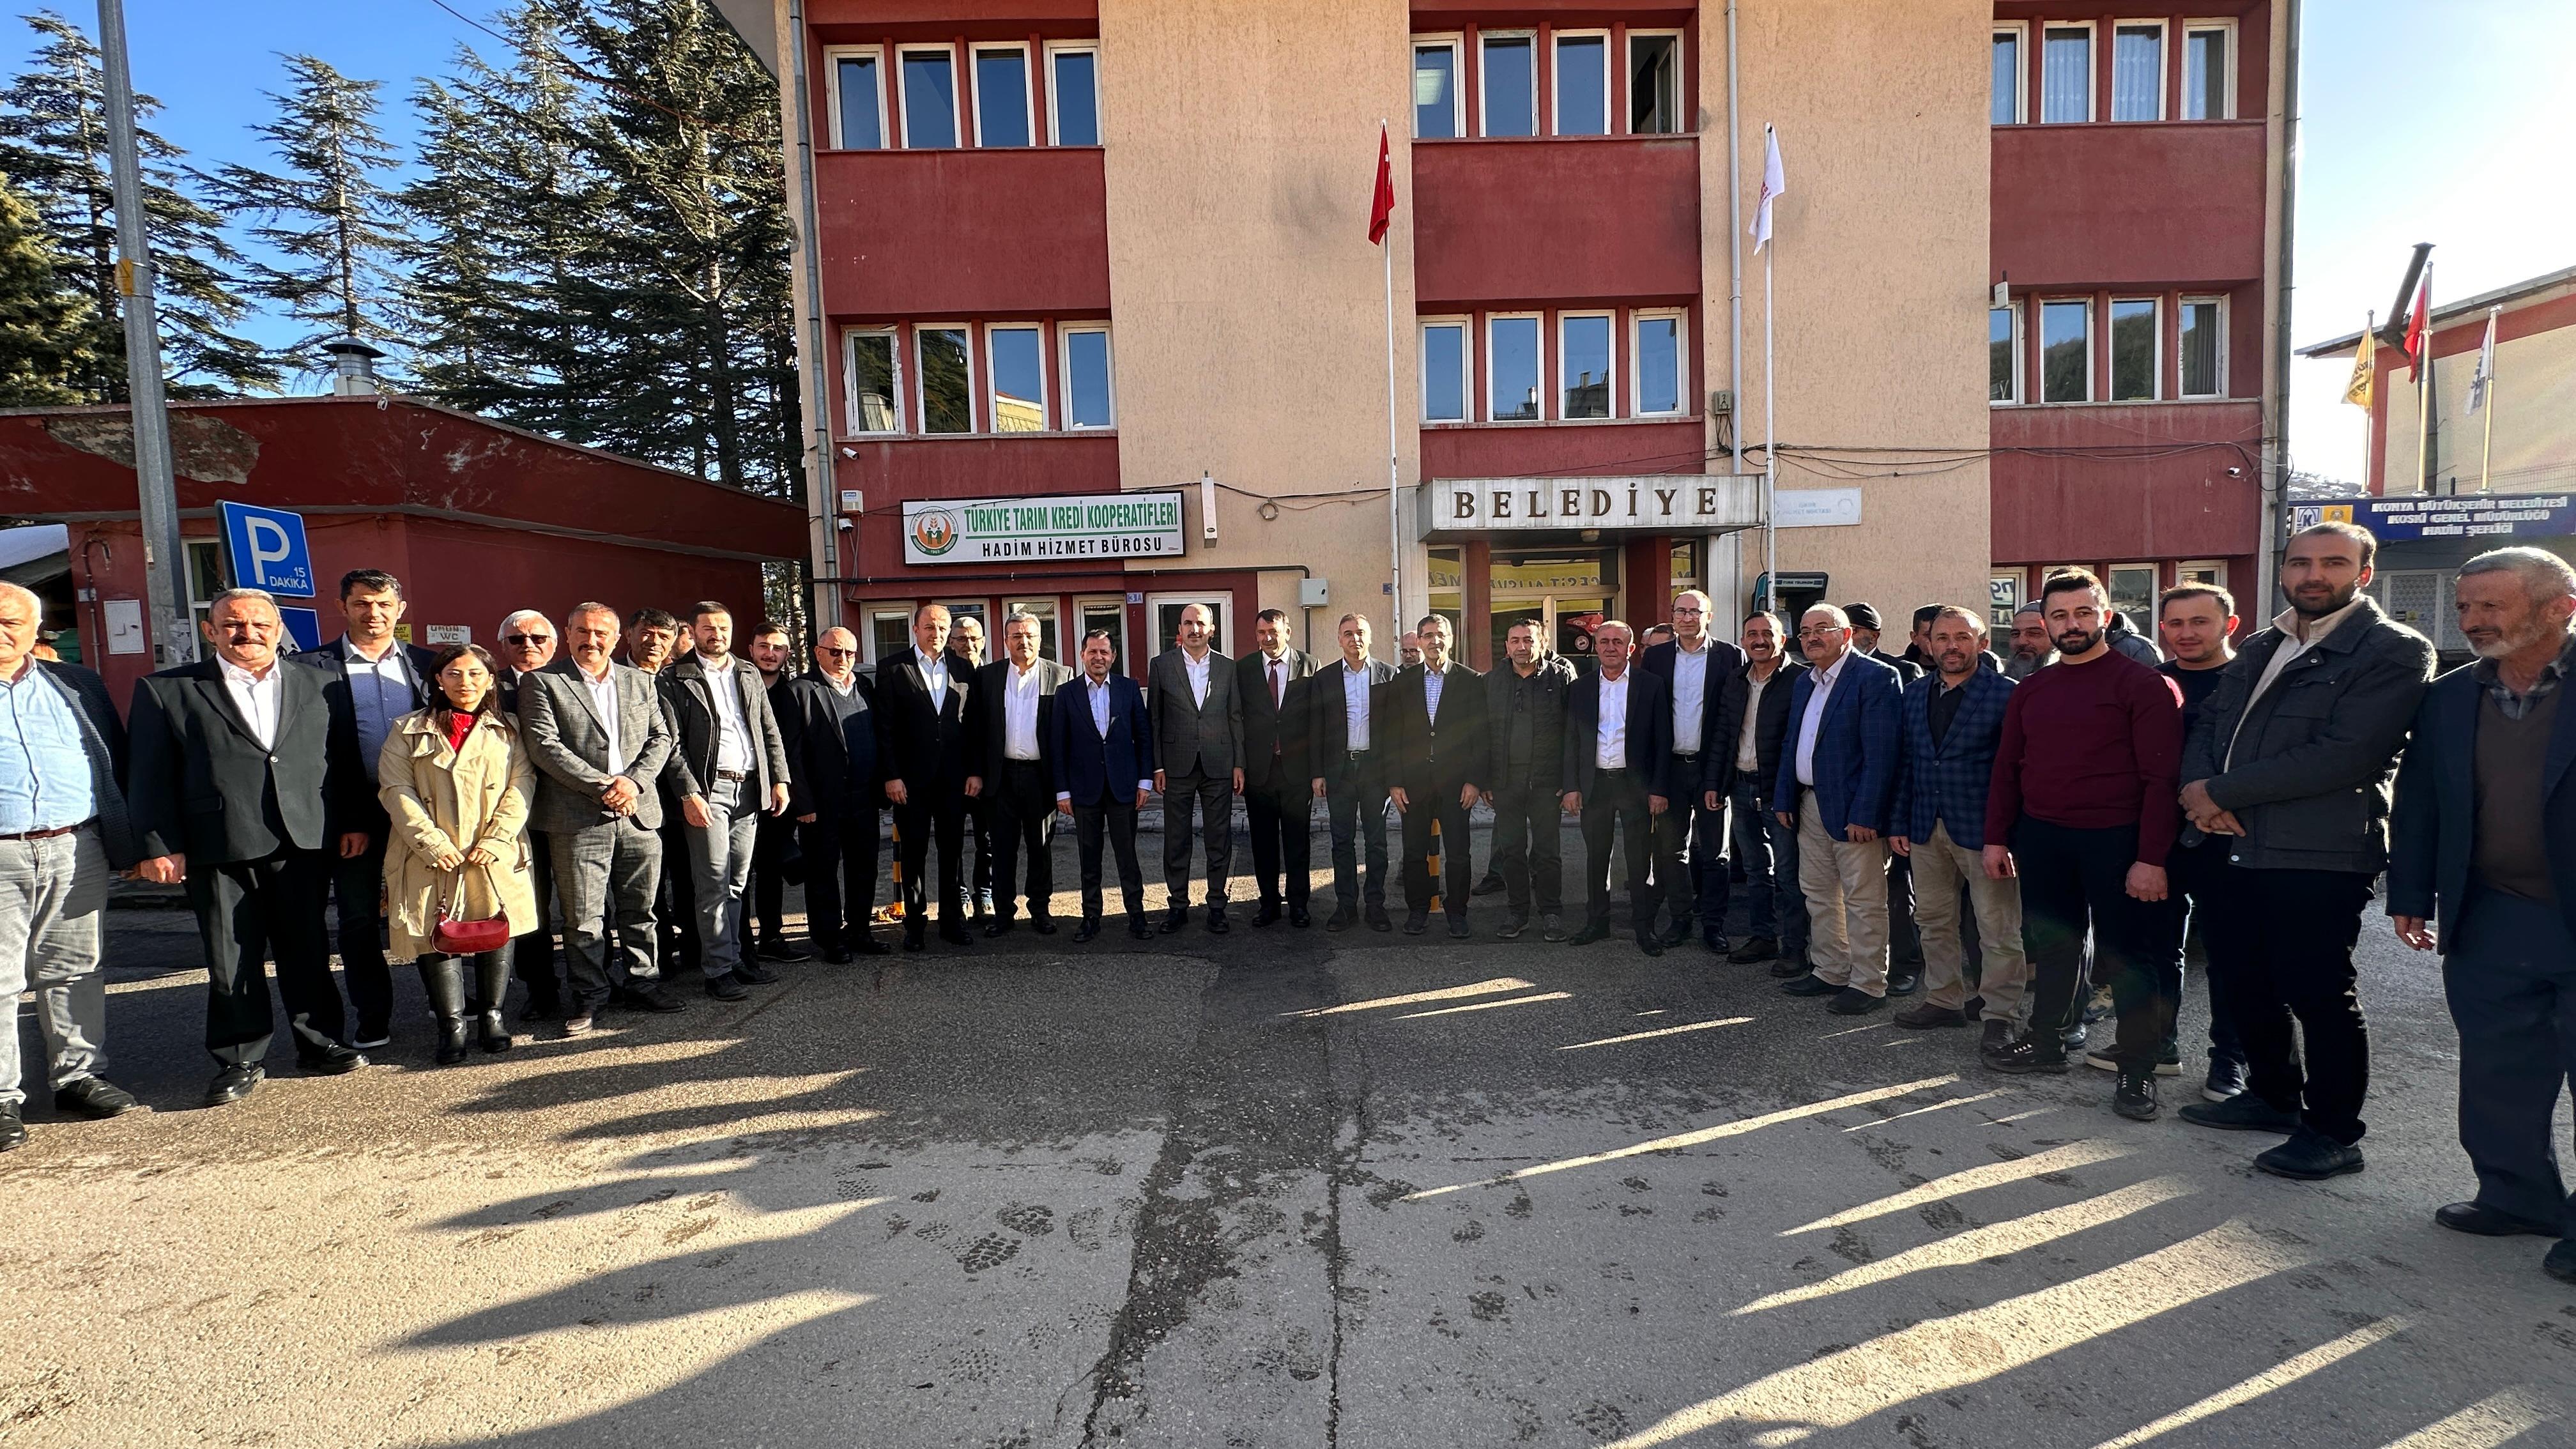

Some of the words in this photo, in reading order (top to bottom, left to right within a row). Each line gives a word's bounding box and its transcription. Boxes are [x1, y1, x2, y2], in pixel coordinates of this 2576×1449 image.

[1453, 482, 1717, 518] BELEDİYE
[2372, 502, 2414, 512] KONYA
[964, 502, 1011, 532] TÜRKİYE
[1013, 507, 1048, 531] TARIM
[1051, 500, 1084, 530] KREDİ
[1087, 496, 1177, 528] KOOPERATİFLERİ
[2430, 513, 2471, 523] GENEL
[245, 516, 291, 585] P
[983, 539, 1031, 557] HADİM
[1038, 538, 1095, 556] HİZMET
[1101, 535, 1162, 553] BÜROSU
[294, 567, 306, 578] 15
[270, 576, 309, 589] DAKİKA
